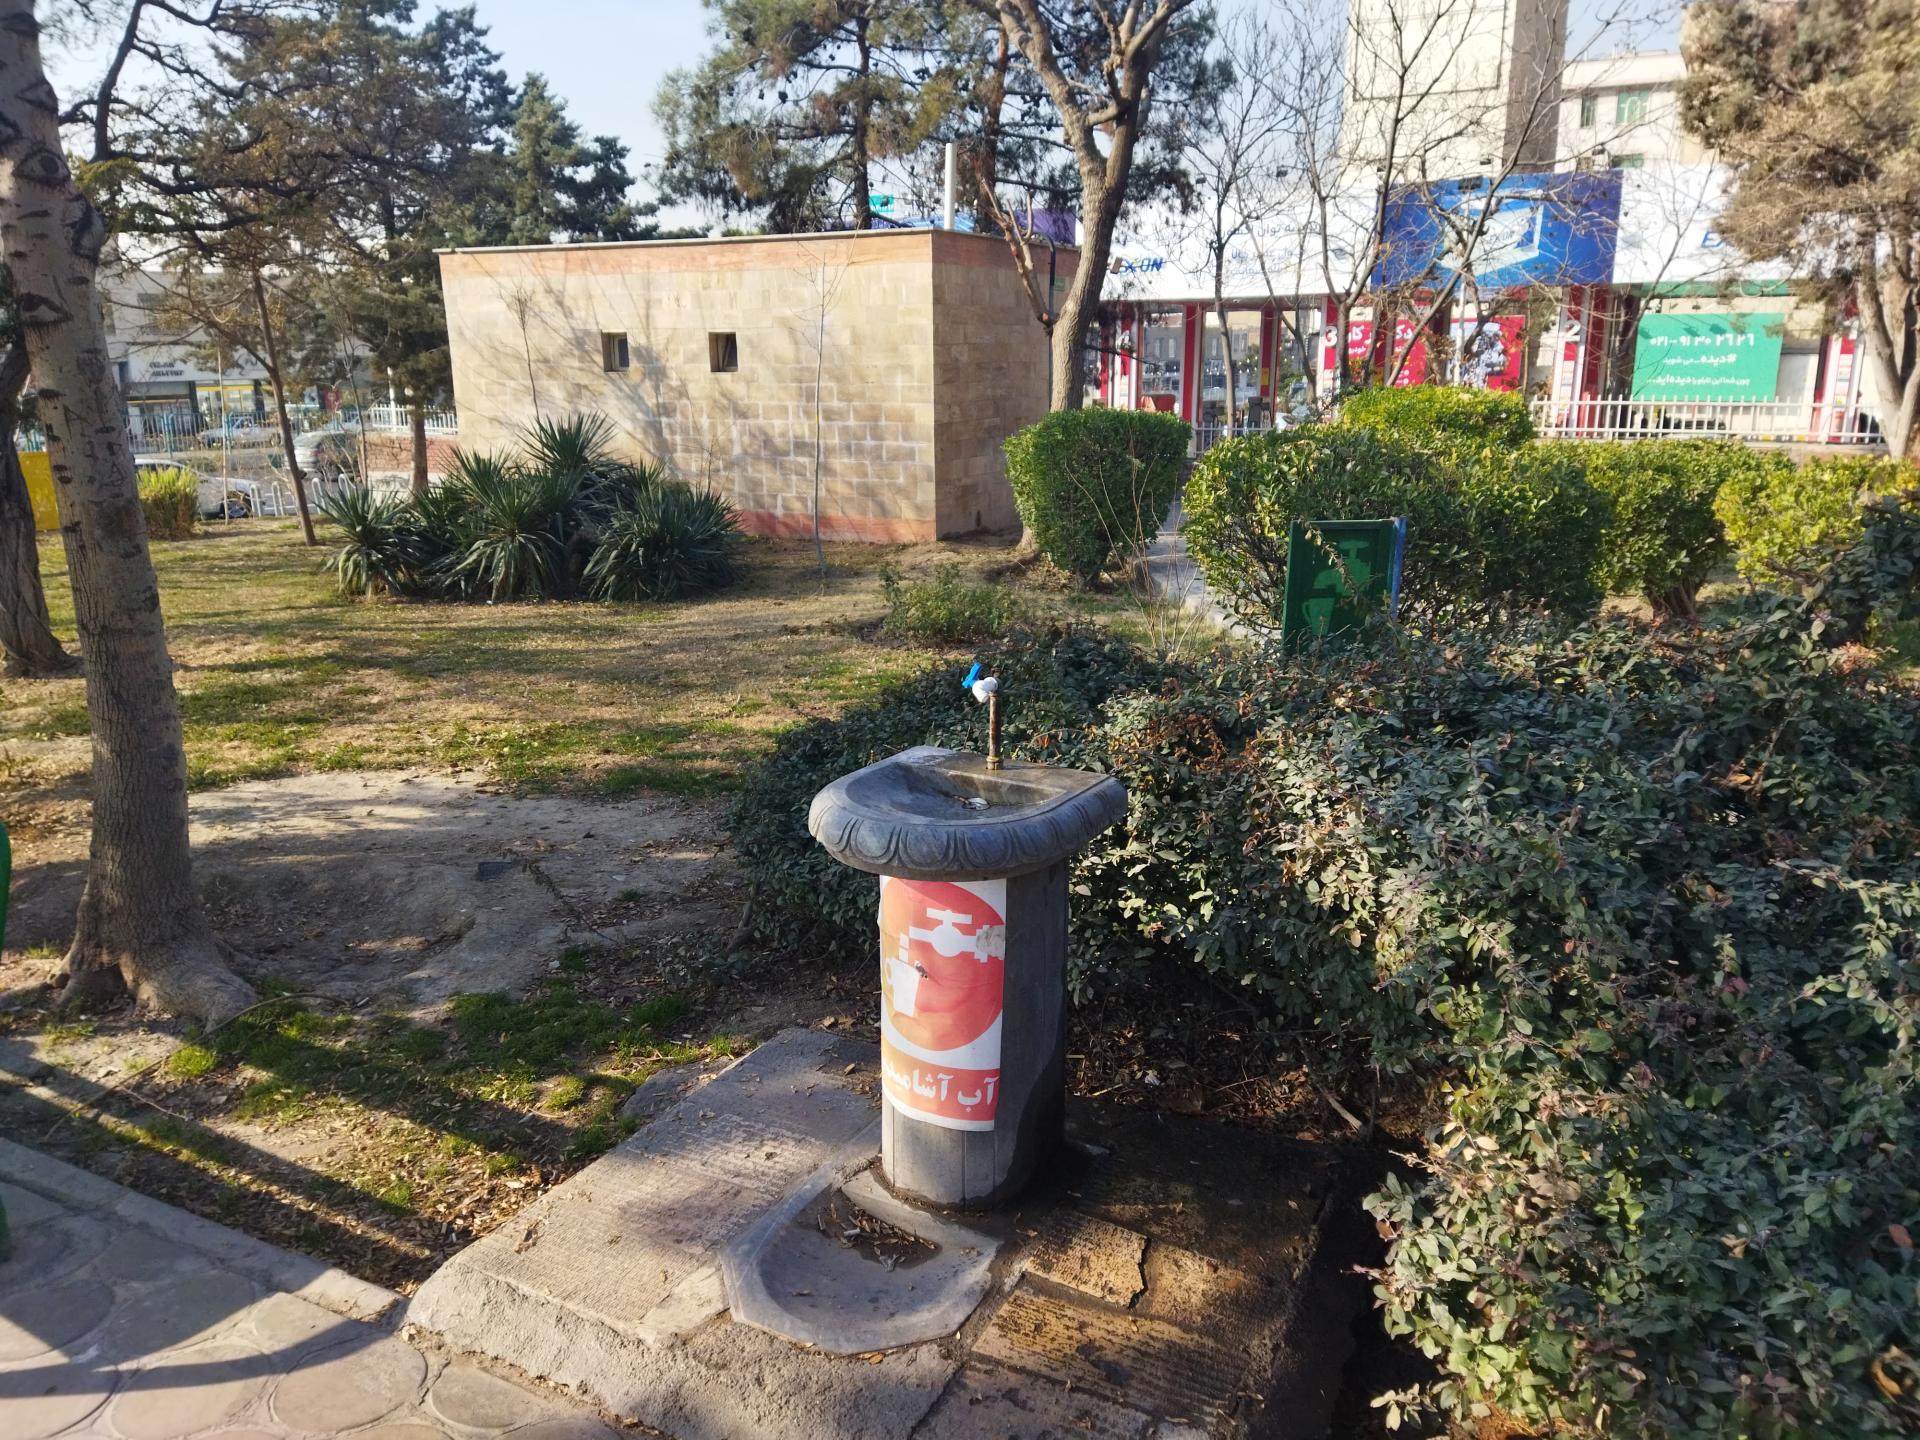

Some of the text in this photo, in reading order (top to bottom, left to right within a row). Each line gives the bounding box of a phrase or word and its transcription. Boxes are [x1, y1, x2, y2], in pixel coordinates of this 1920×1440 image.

[1324, 325, 1338, 347] 3
[1564, 319, 1581, 342] 2
[957, 1075, 999, 1113] آب
